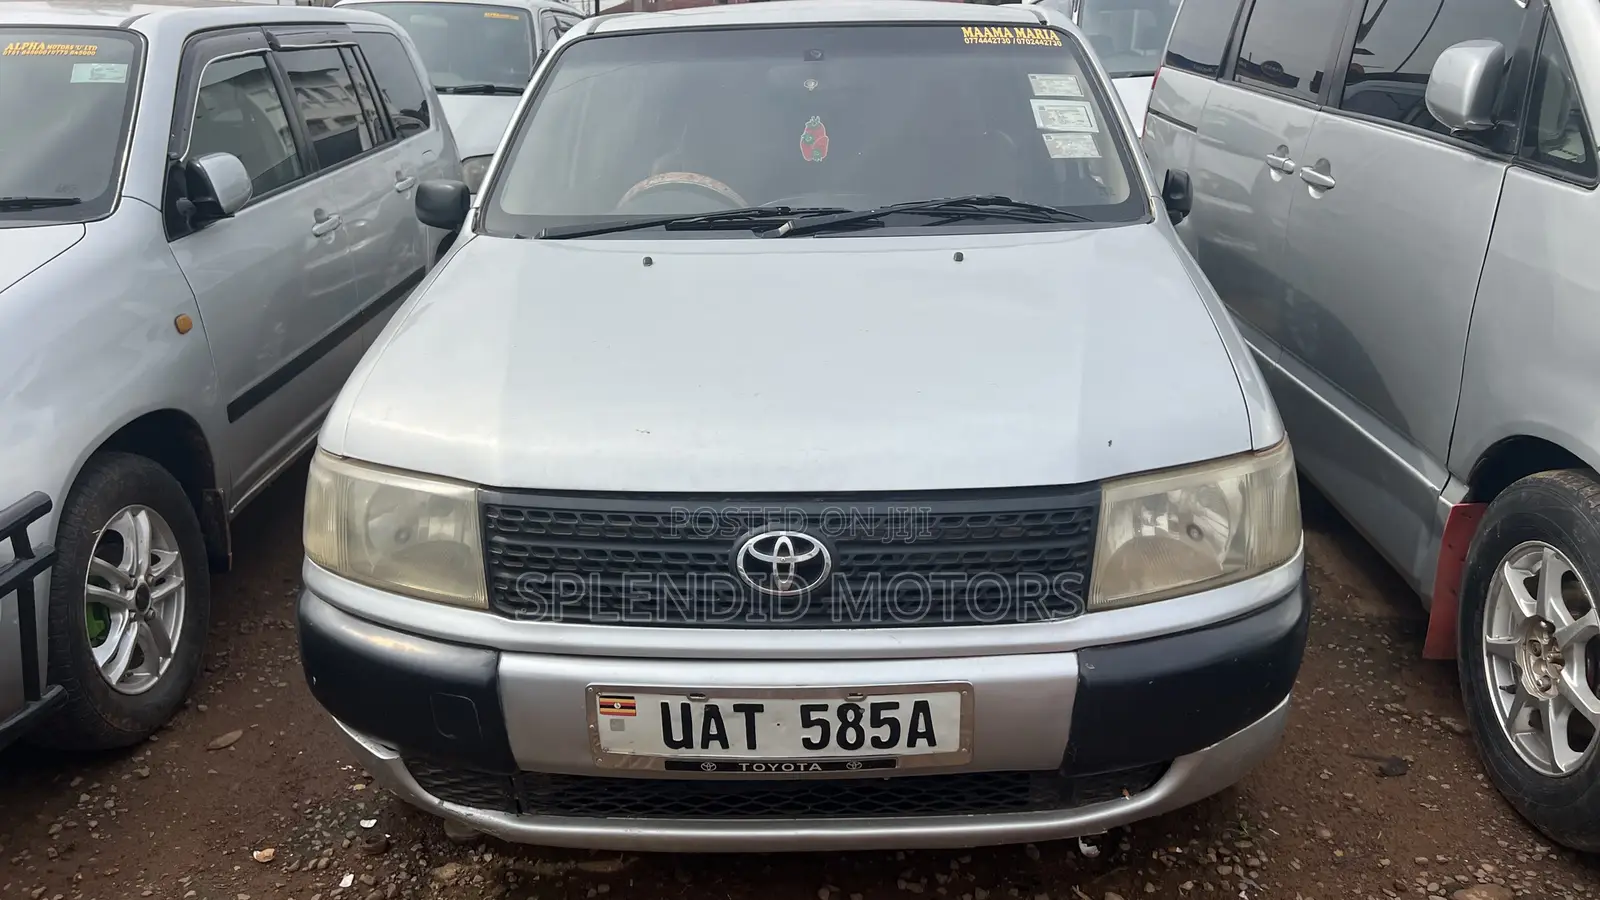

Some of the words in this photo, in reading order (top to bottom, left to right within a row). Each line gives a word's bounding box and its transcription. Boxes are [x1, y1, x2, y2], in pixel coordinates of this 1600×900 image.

[961, 27, 1014, 38] MAAMA
[1014, 28, 1060, 40] MARIA
[5, 42, 45, 51] ALPHA
[660, 701, 764, 750] UAT
[800, 700, 937, 750] 585A
[738, 762, 822, 772] TOYOTA
